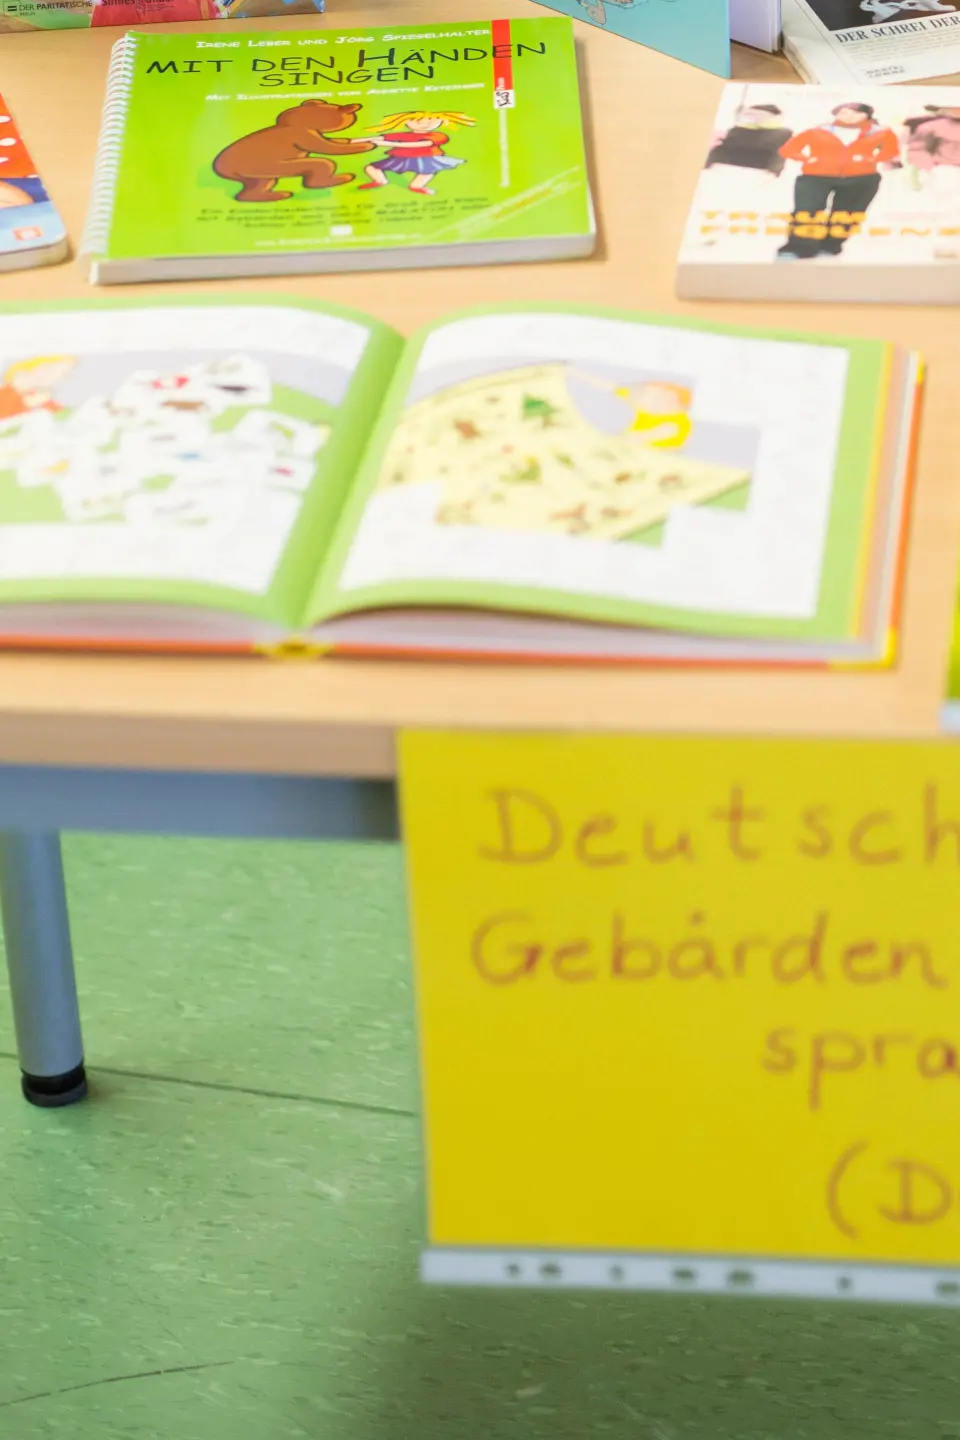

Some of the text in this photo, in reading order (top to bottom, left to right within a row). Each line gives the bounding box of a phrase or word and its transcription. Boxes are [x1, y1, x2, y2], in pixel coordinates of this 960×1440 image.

[835, 31, 869, 44] DER
[870, 21, 927, 39] SCHREI
[146, 42, 546, 74] MIT DEN HÄNDEN
[258, 65, 435, 87] SINGEN
